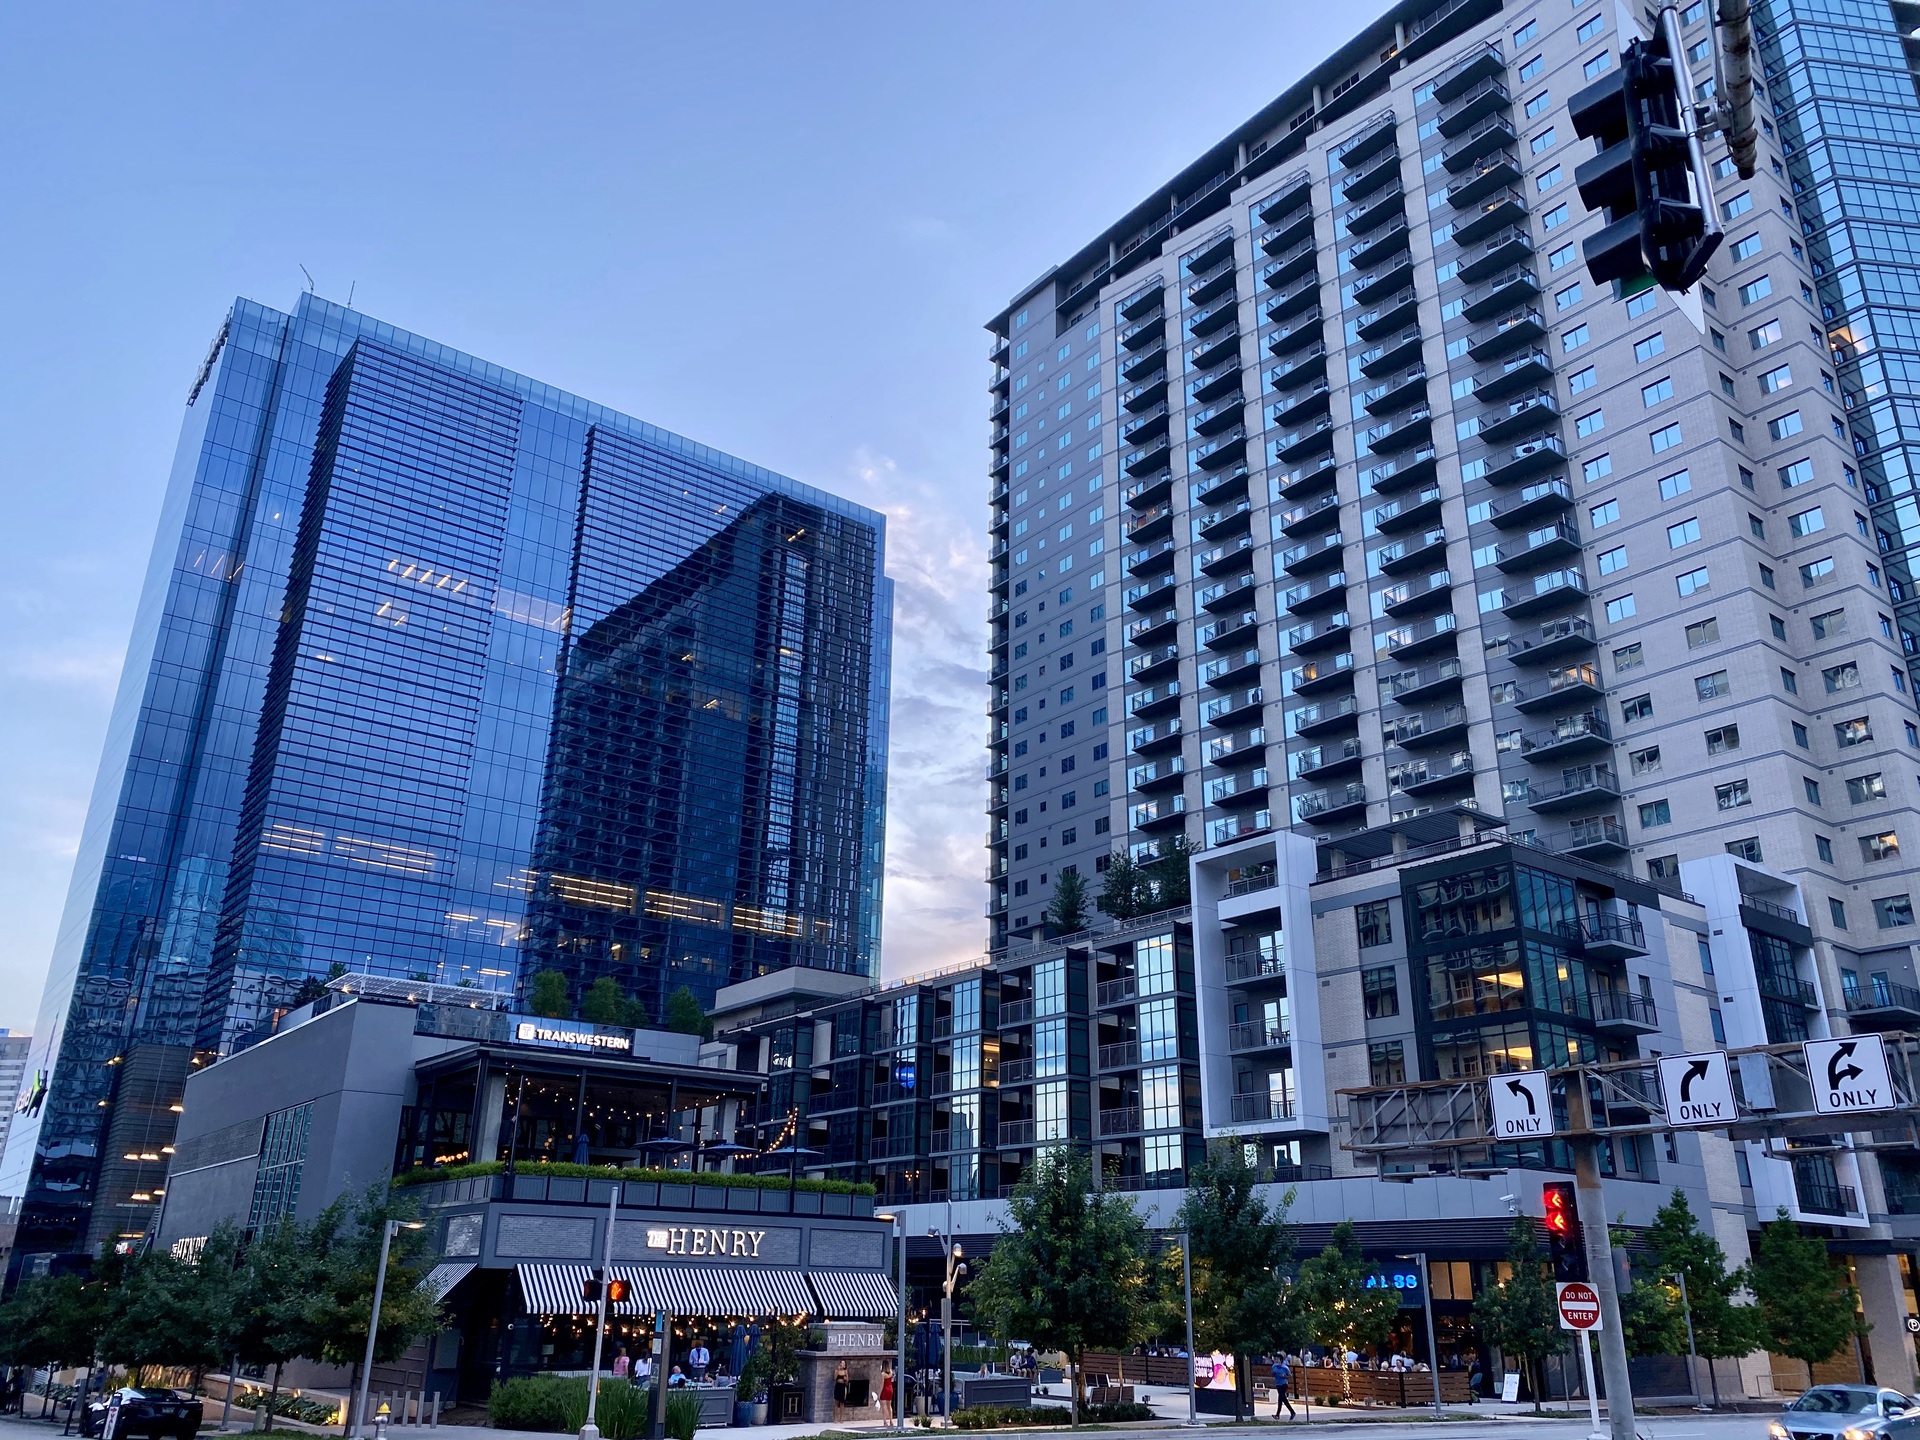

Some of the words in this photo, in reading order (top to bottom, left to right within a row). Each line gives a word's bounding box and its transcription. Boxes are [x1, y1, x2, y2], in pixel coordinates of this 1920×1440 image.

[536, 1028, 629, 1049] TRANSWESTERN
[1829, 1089, 1877, 1108] ONLY
[1679, 1102, 1721, 1120] ONLY
[1505, 1118, 1541, 1133] ONLY
[647, 1230, 668, 1248] THE
[667, 1228, 765, 1257] HENRY
[1393, 1274, 1417, 1289] 38
[1565, 1291, 1576, 1300] DO
[1578, 1291, 1592, 1300] NOT
[1567, 1311, 1594, 1321] ENTER
[837, 1333, 884, 1347] HENRY
[788, 1397, 799, 1413] H
